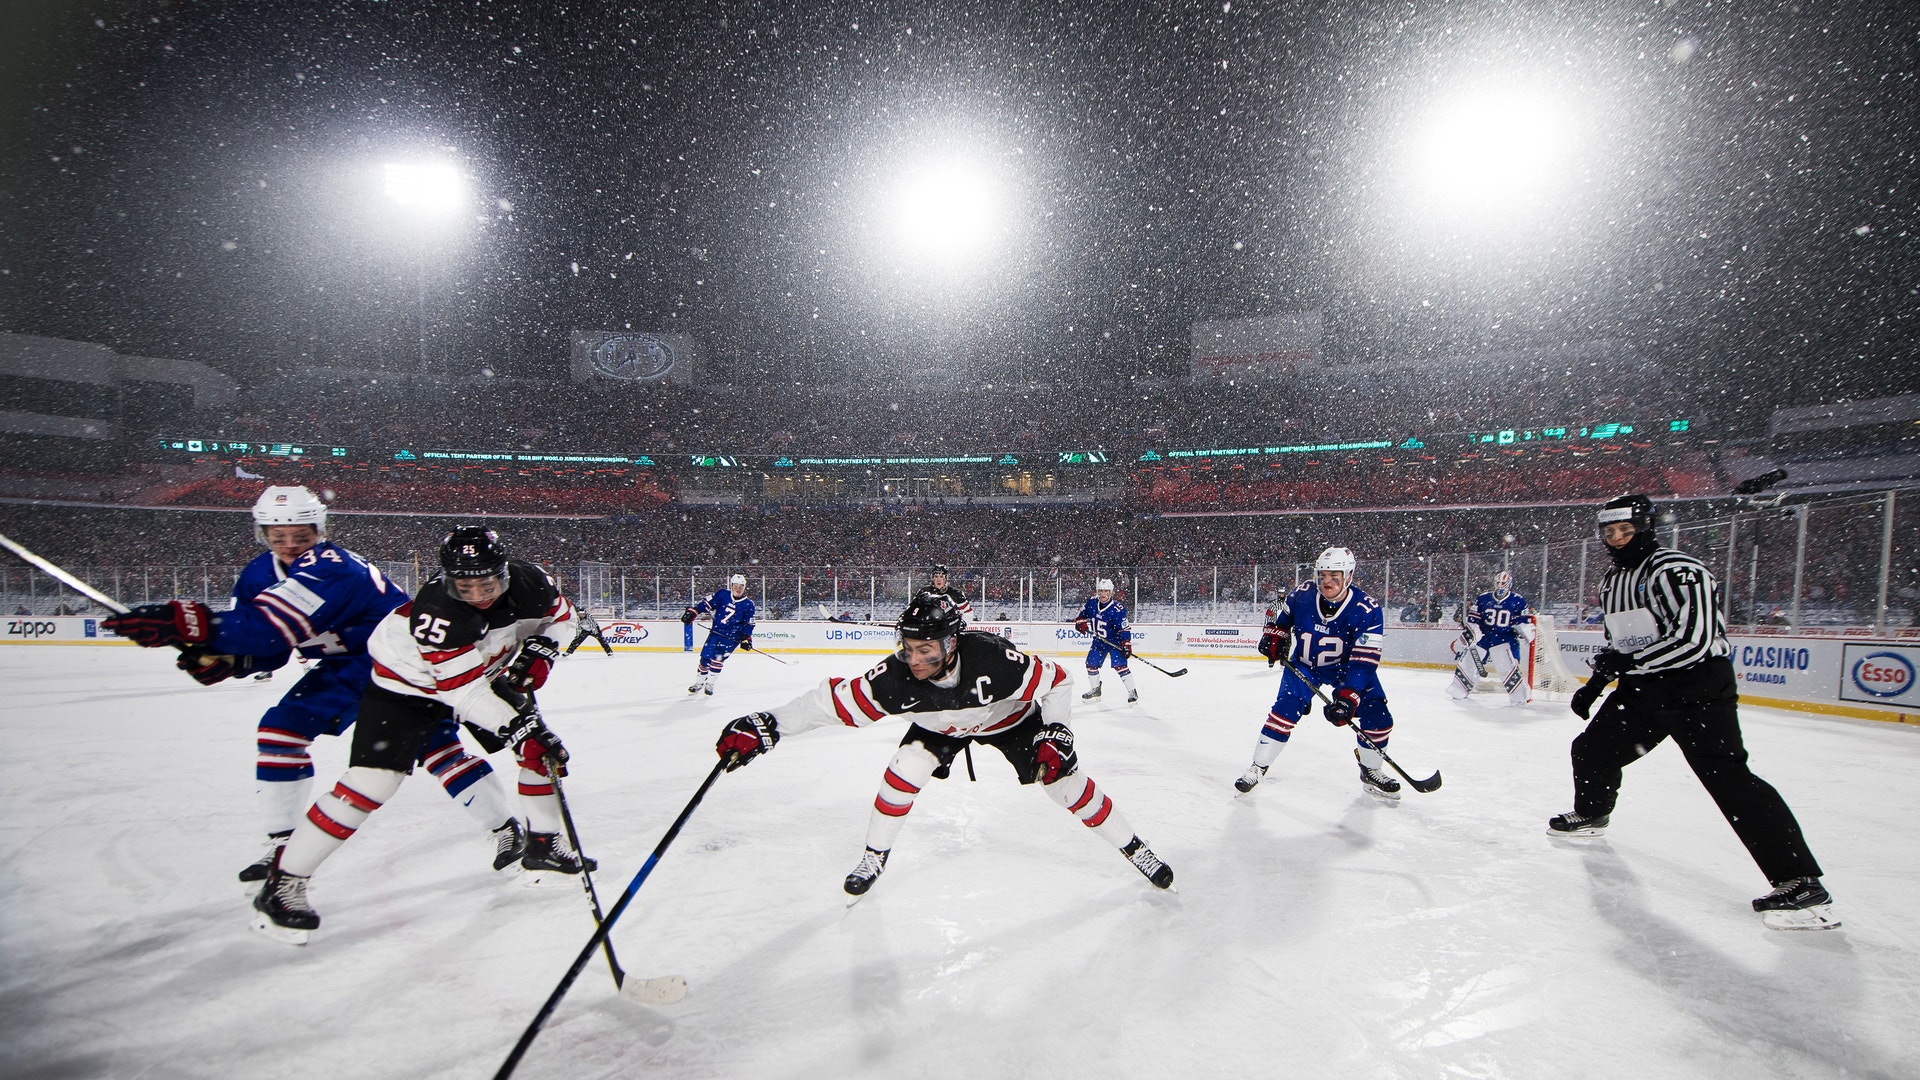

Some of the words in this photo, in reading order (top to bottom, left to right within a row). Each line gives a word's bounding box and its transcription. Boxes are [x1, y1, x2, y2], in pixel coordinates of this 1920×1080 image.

[602, 332, 661, 341] BENRUS
[1524, 431, 1532, 440] 3
[1339, 441, 1392, 450] CHAMPIONSHIPS
[462, 545, 475, 554] 25
[298, 549, 343, 568] 34
[1677, 572, 1696, 584] 74
[912, 608, 920, 616] 9
[1114, 602, 1124, 612] 15
[1356, 596, 1380, 614] 12
[180, 600, 200, 638] UER
[720, 606, 736, 624] 7
[1484, 608, 1510, 627] 30
[414, 613, 451, 644] 25
[826, 630, 842, 640] UB
[846, 630, 862, 640] MD
[1092, 618, 1108, 638] 15
[1314, 624, 1330, 635] USA
[1300, 632, 1344, 667] 12
[1560, 644, 1590, 652] POWER
[1618, 634, 1654, 648] eridian
[526, 642, 559, 660] BAU
[1005, 648, 1025, 665] 9
[1742, 646, 1810, 670] CASINO
[867, 662, 888, 682] 9
[1746, 672, 1786, 685] CANADA
[976, 675, 994, 705] C
[748, 712, 774, 751] BAUER
